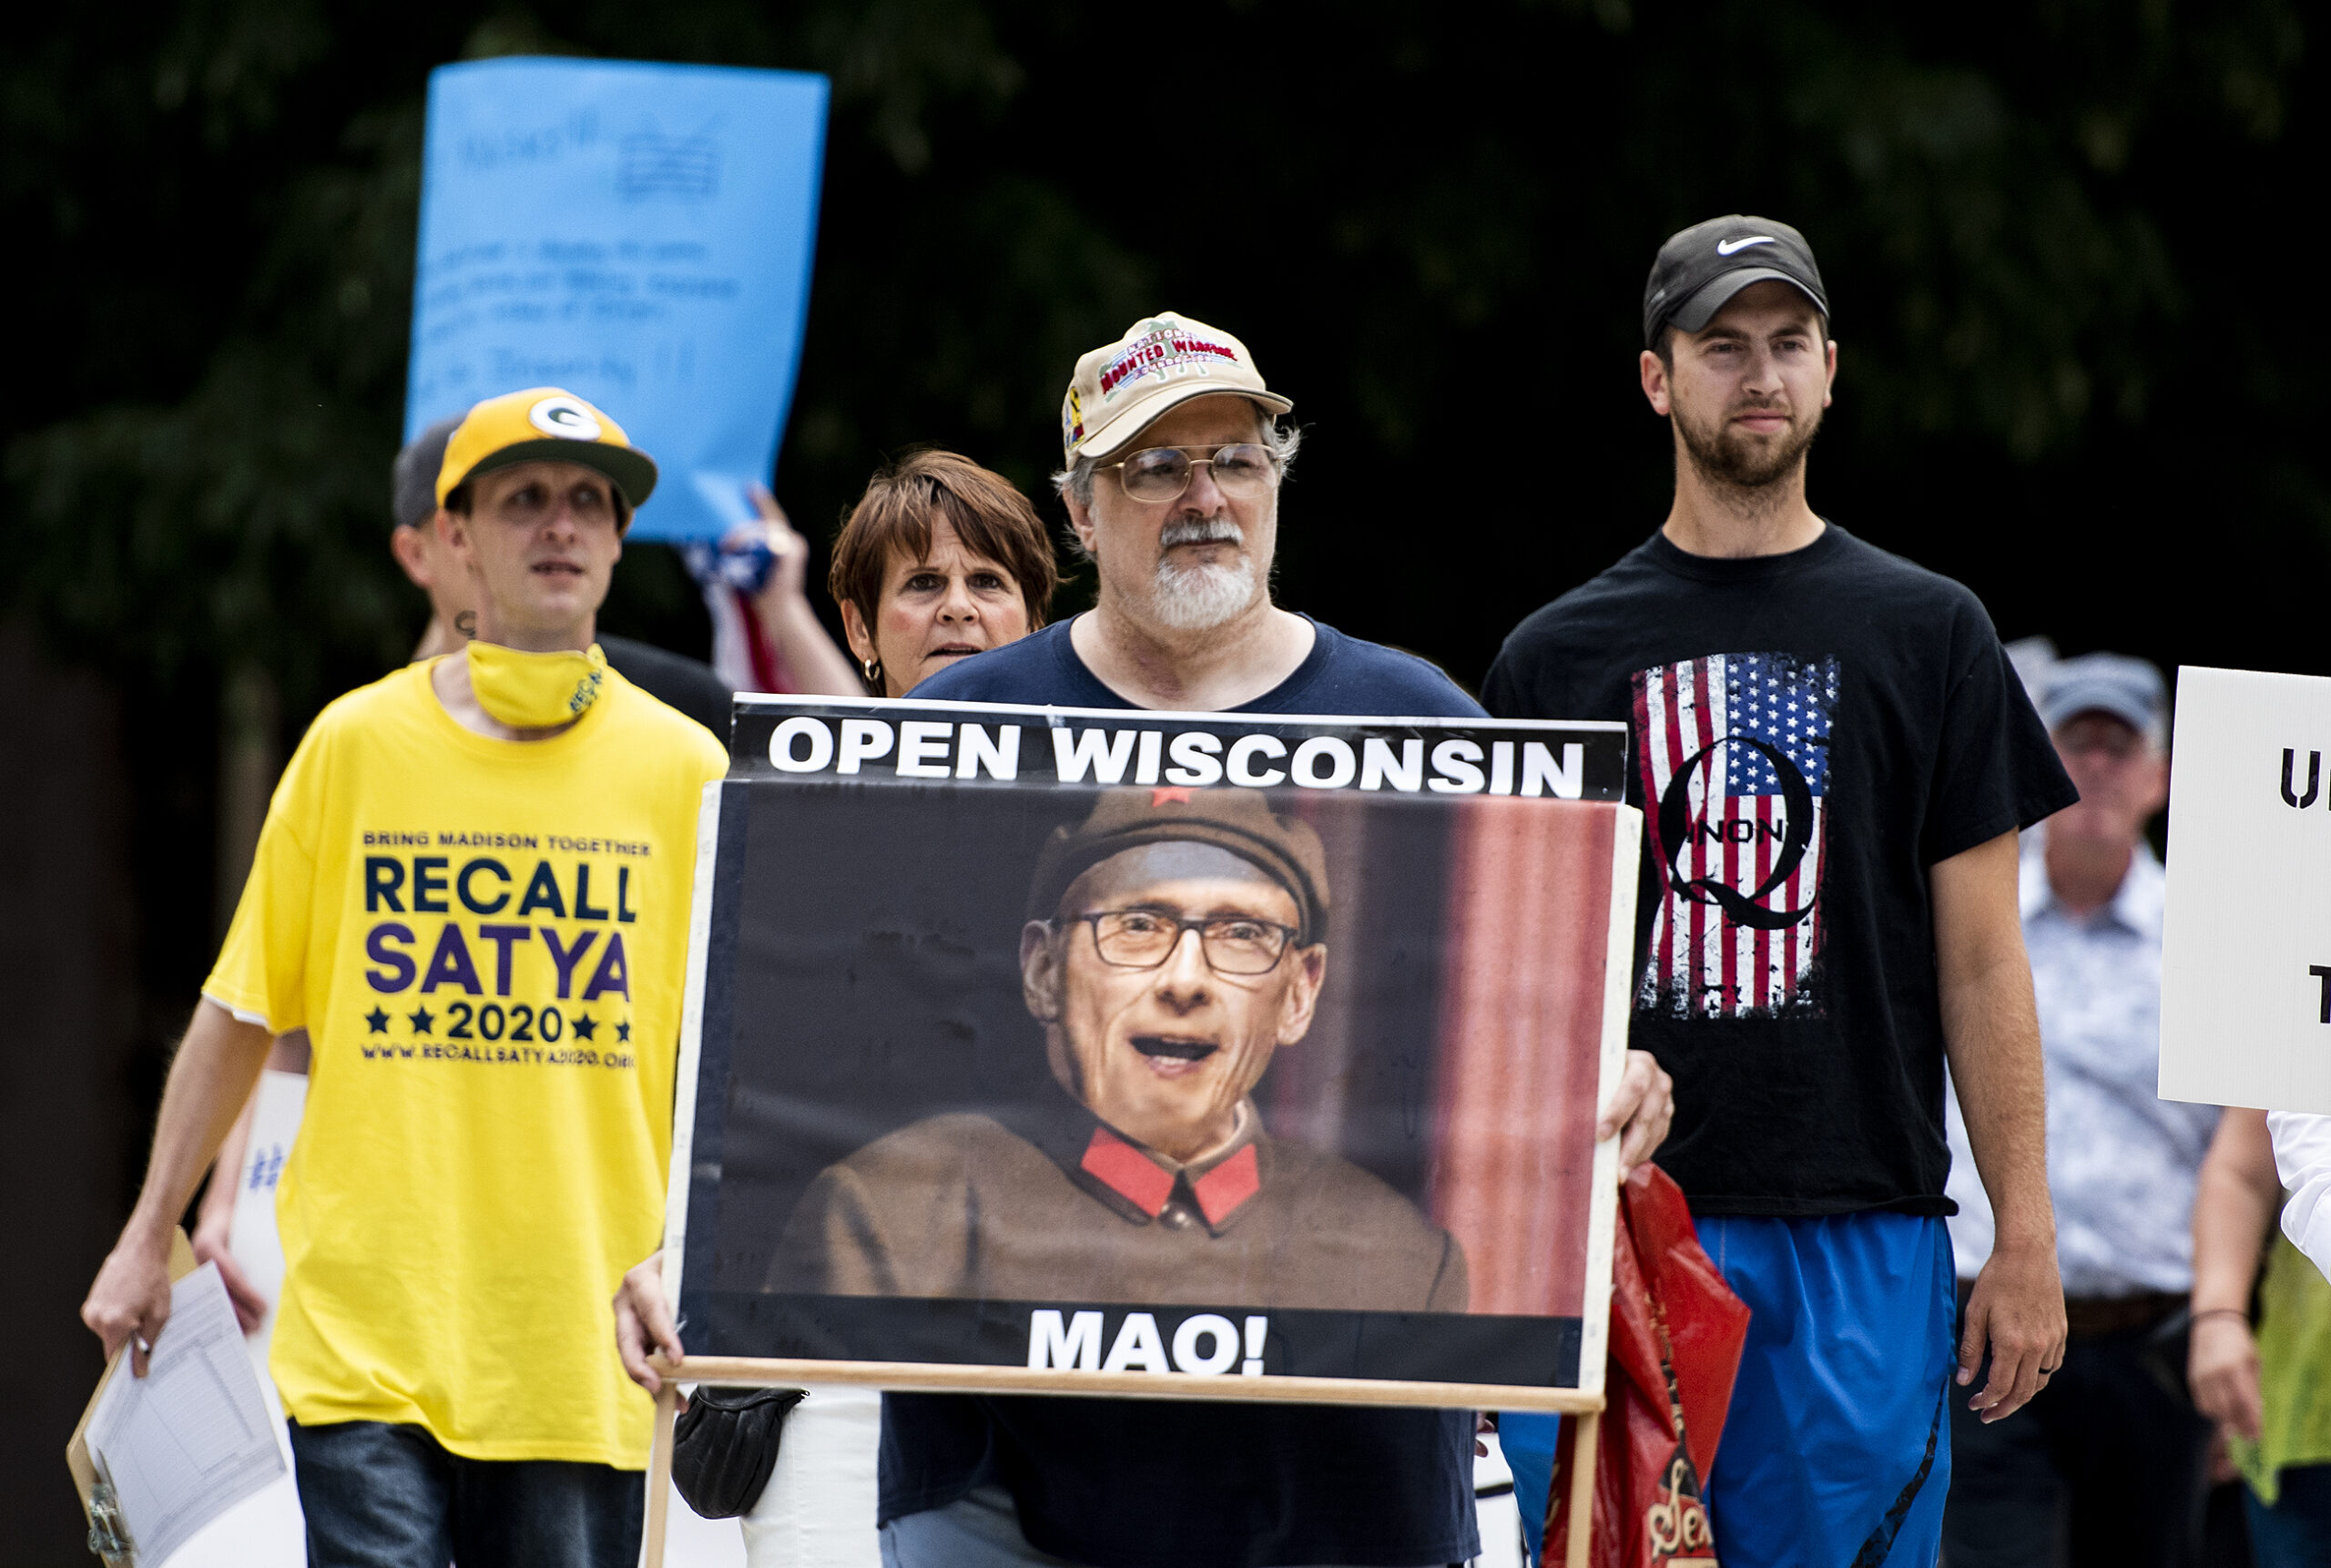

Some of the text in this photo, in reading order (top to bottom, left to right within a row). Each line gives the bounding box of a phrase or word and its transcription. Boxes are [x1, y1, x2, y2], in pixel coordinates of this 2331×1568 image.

[1100, 344, 1165, 394] MOUNTED
[1126, 329, 1196, 354] NATIONA
[769, 717, 1583, 799] OPEN WISCONSIN
[2280, 748, 2331, 810] U
[363, 830, 652, 856] BRING MADISON TOGETHER
[365, 857, 637, 922] RECALL
[365, 922, 630, 1002] SATYA
[447, 1003, 563, 1043] 2020
[1027, 1309, 1267, 1377] MAO!
